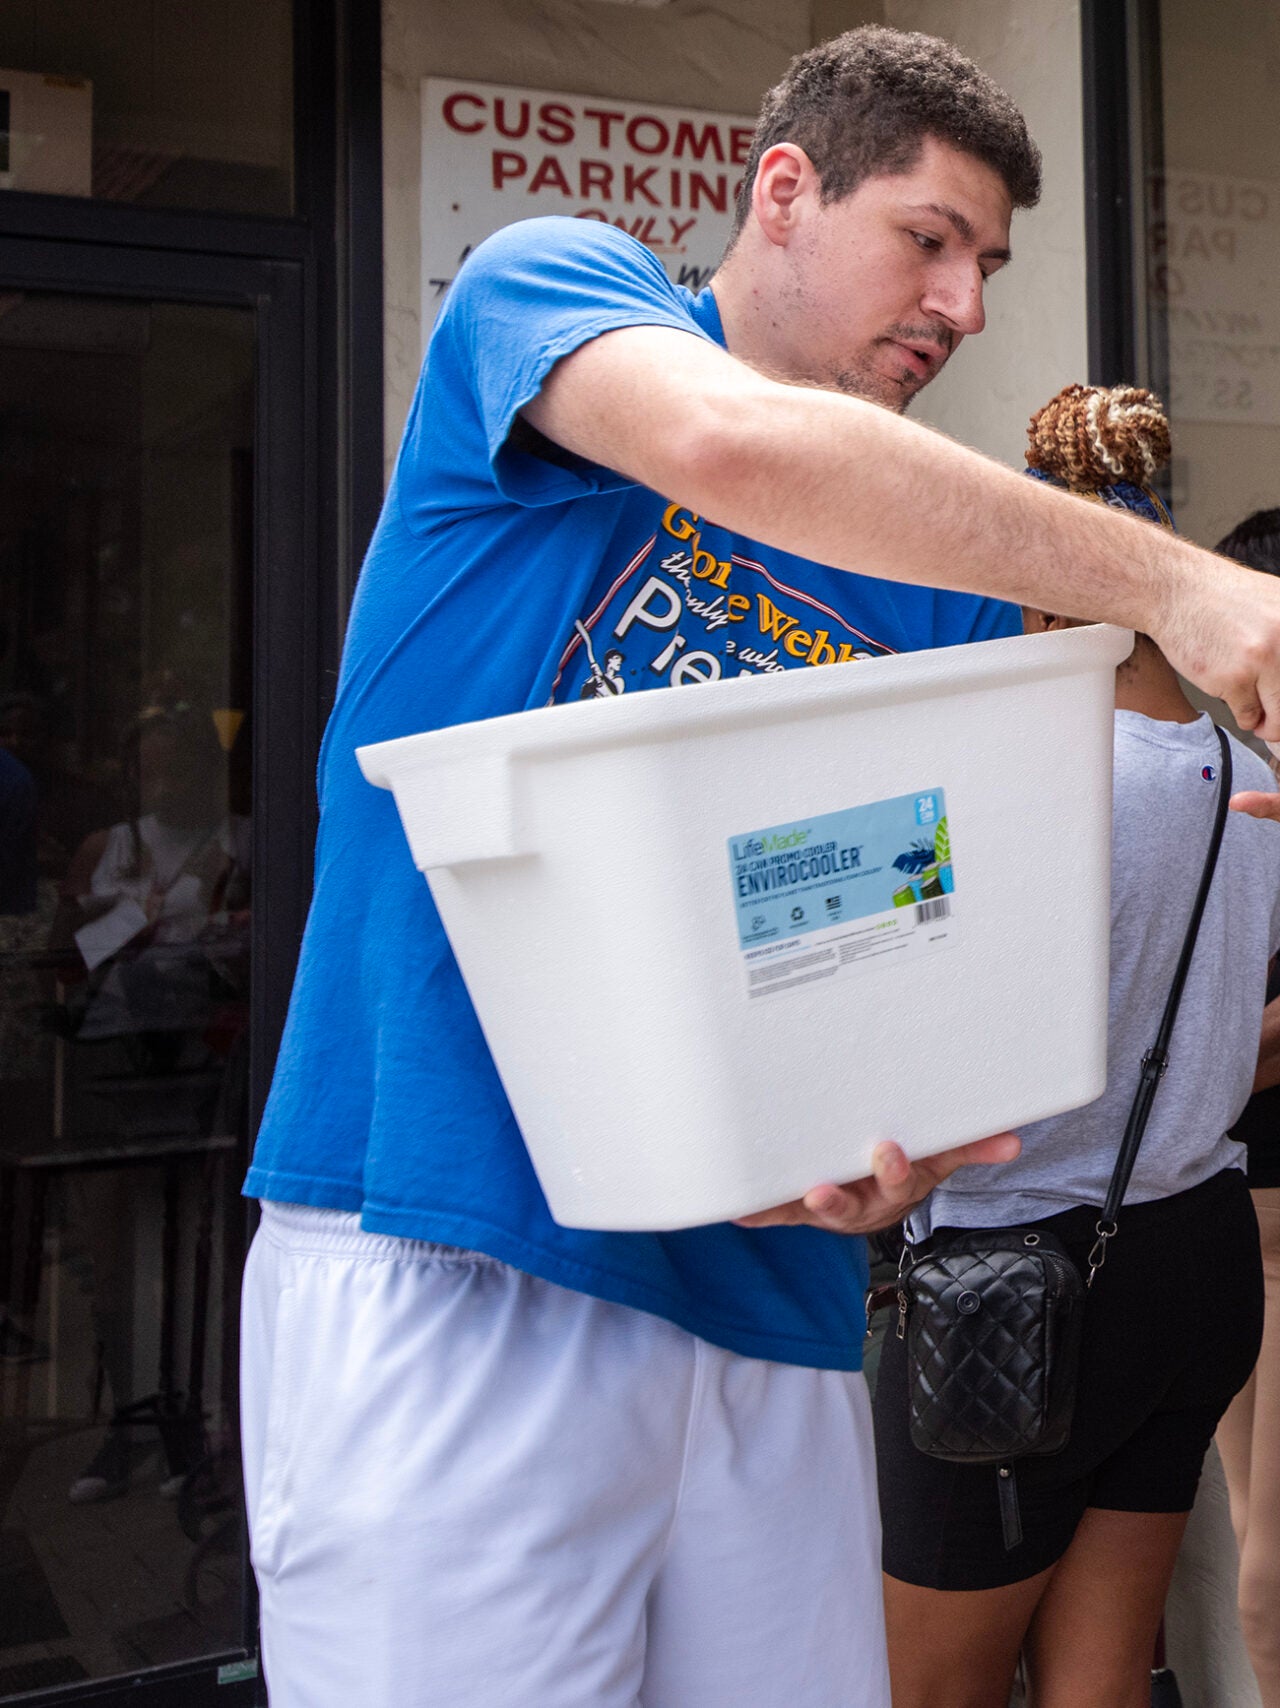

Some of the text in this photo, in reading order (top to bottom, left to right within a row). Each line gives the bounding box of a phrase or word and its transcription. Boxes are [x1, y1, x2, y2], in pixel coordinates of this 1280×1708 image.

[442, 92, 756, 165] CUSTOME
[491, 150, 746, 213] PARKIN
[575, 208, 698, 246] NLY
[613, 576, 752, 687] Pre
[738, 847, 861, 898] ENVIROCOOLER
